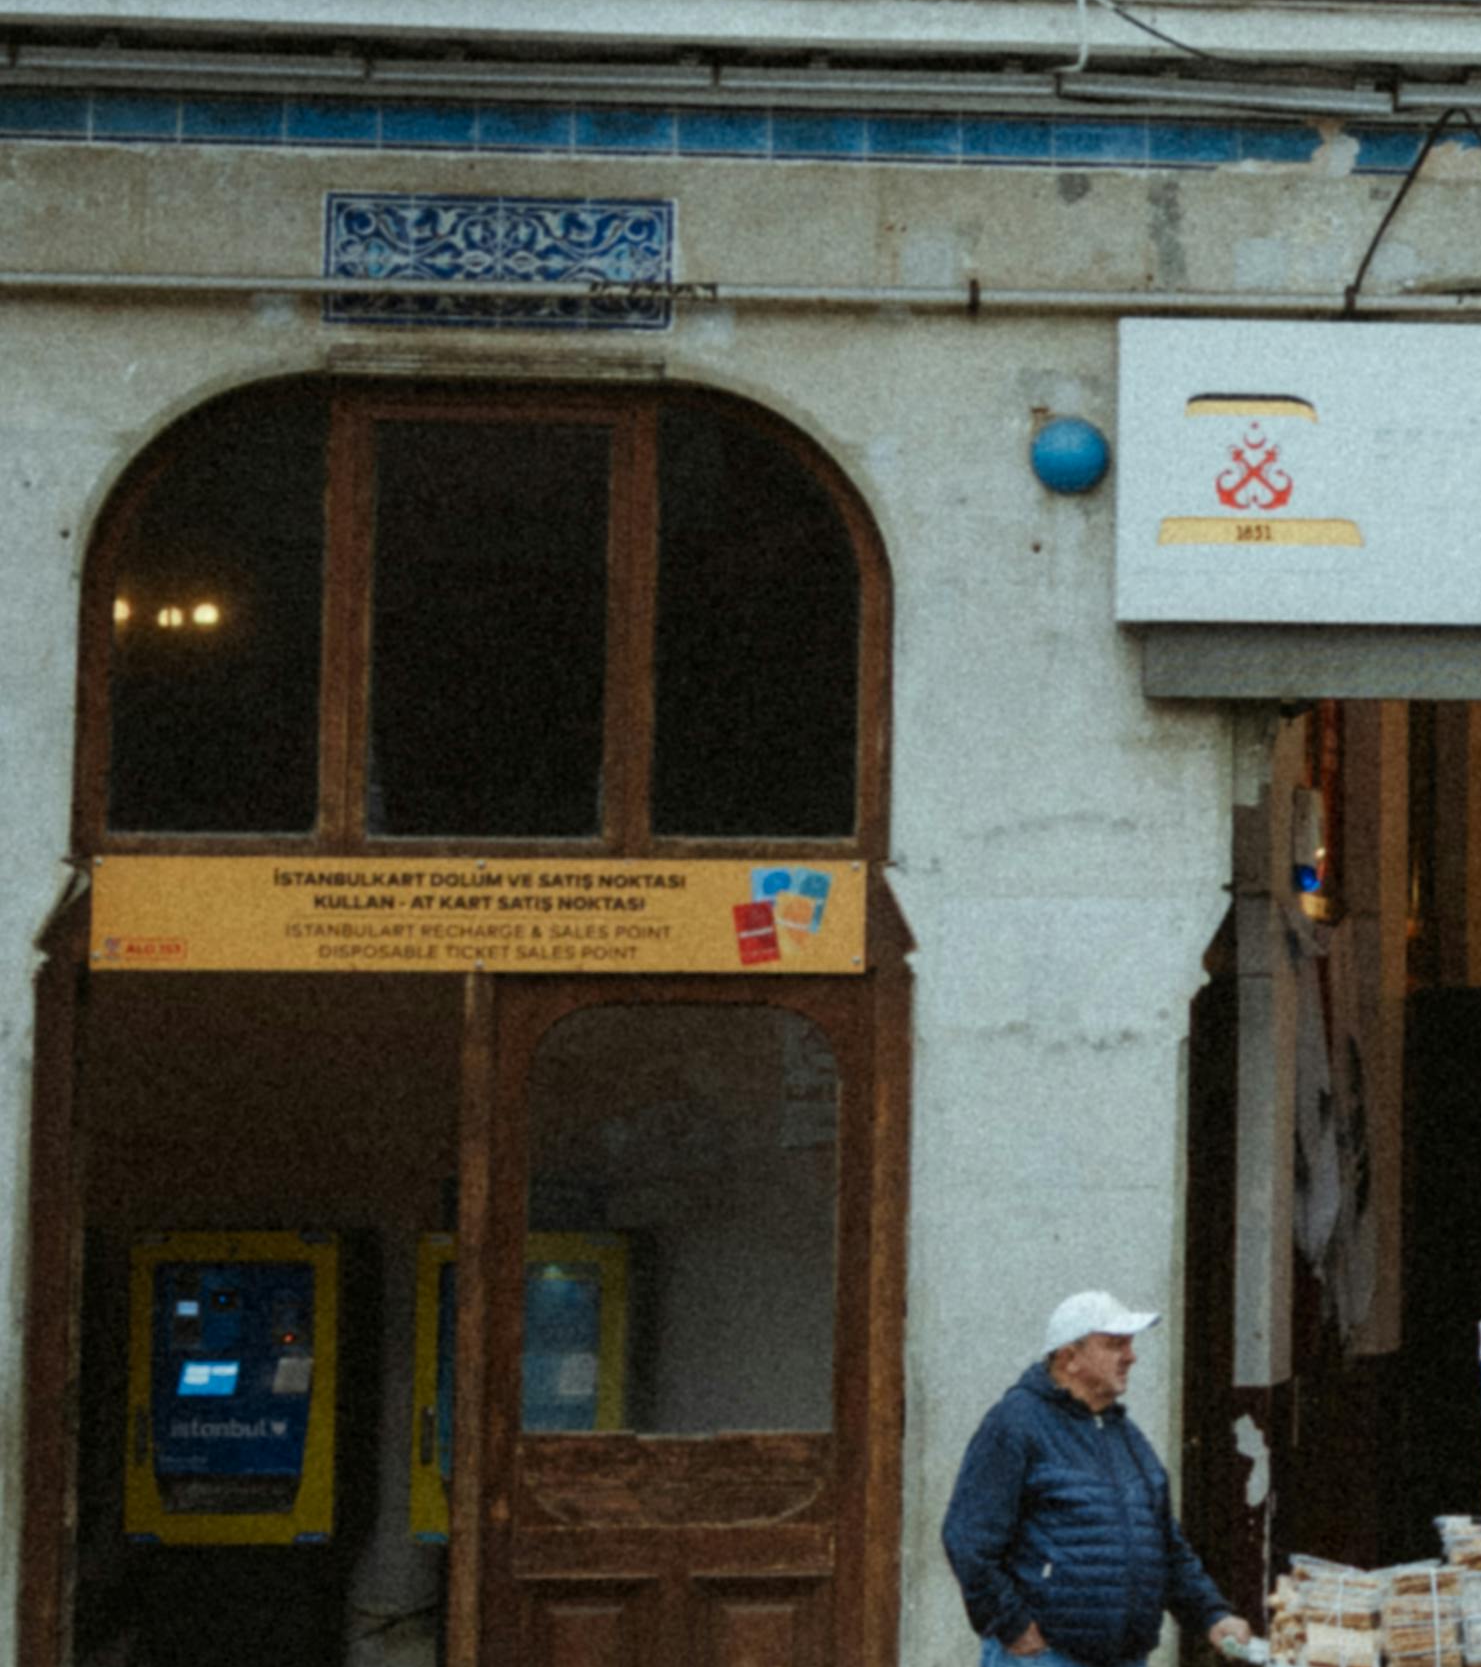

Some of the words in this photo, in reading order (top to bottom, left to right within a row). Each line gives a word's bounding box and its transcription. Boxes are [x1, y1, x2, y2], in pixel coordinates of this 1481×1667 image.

[273, 867, 425, 887] İSTANBULKART
[430, 872, 502, 887] DOLUM
[507, 873, 532, 888] VE
[538, 873, 594, 891] SATIŞ
[599, 874, 686, 889] NOKTASI
[313, 895, 395, 910] KULLAN
[411, 895, 435, 910] AT
[439, 895, 493, 911] KART
[498, 896, 553, 913] SATIŞ
[558, 896, 646, 911] NOKTASI
[420, 924, 525, 939] RECHARGE
[531, 925, 542, 939] &
[550, 925, 609, 939] SALES
[615, 926, 671, 940] POINT
[319, 944, 438, 959] DISPOSABLE
[444, 945, 509, 959] TICKET
[515, 945, 576, 960] SALES
[581, 946, 637, 960] POINT
[170, 1419, 267, 1438] istanbul
